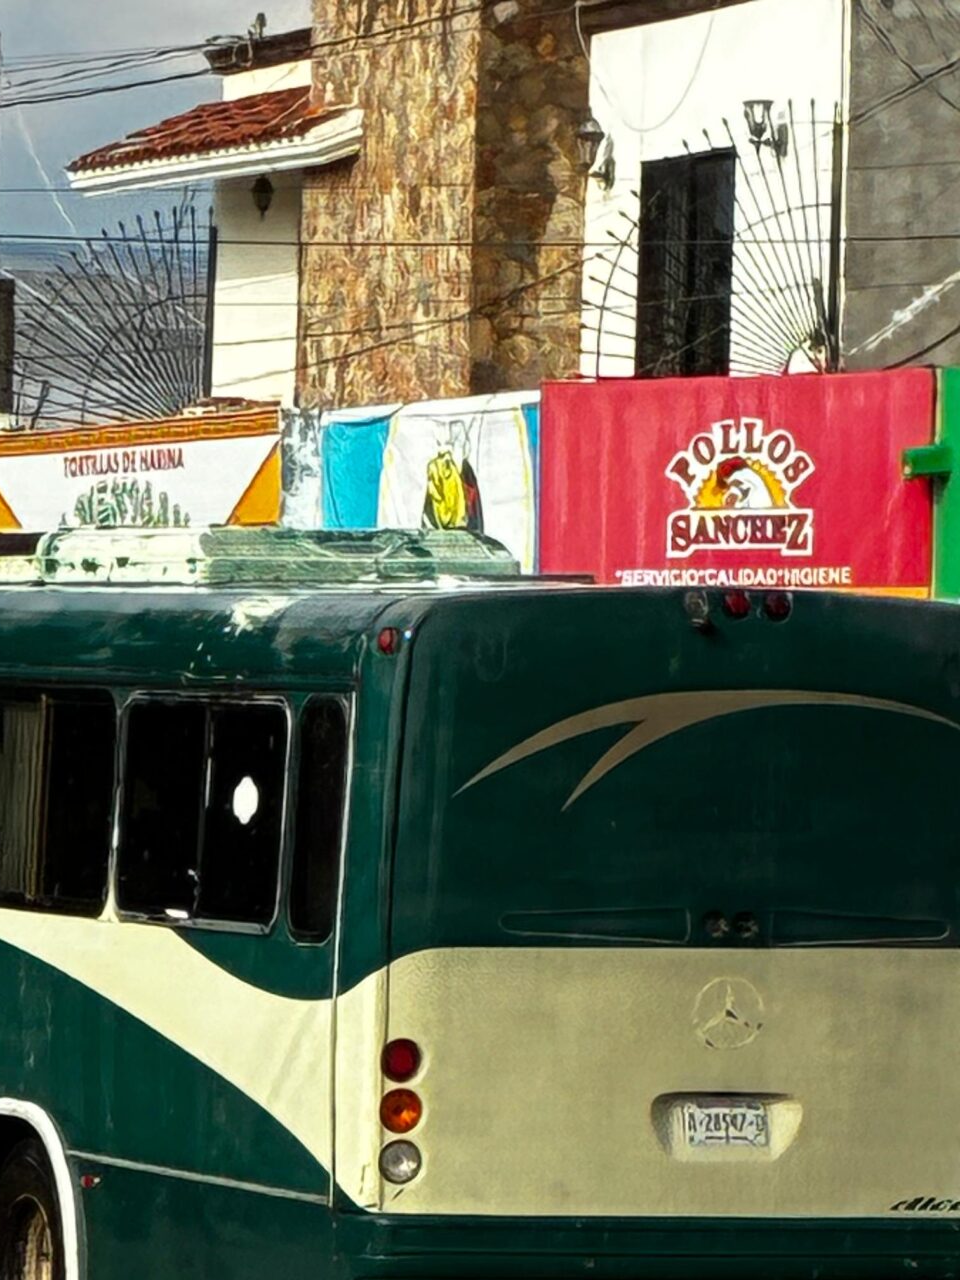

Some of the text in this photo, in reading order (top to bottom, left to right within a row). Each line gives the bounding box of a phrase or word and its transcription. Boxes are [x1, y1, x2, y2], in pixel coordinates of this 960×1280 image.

[63, 452, 119, 478] TORTILLAS
[122, 451, 137, 473] DE
[670, 422, 810, 488] POLLOS
[671, 513, 809, 551] SANCHEZ
